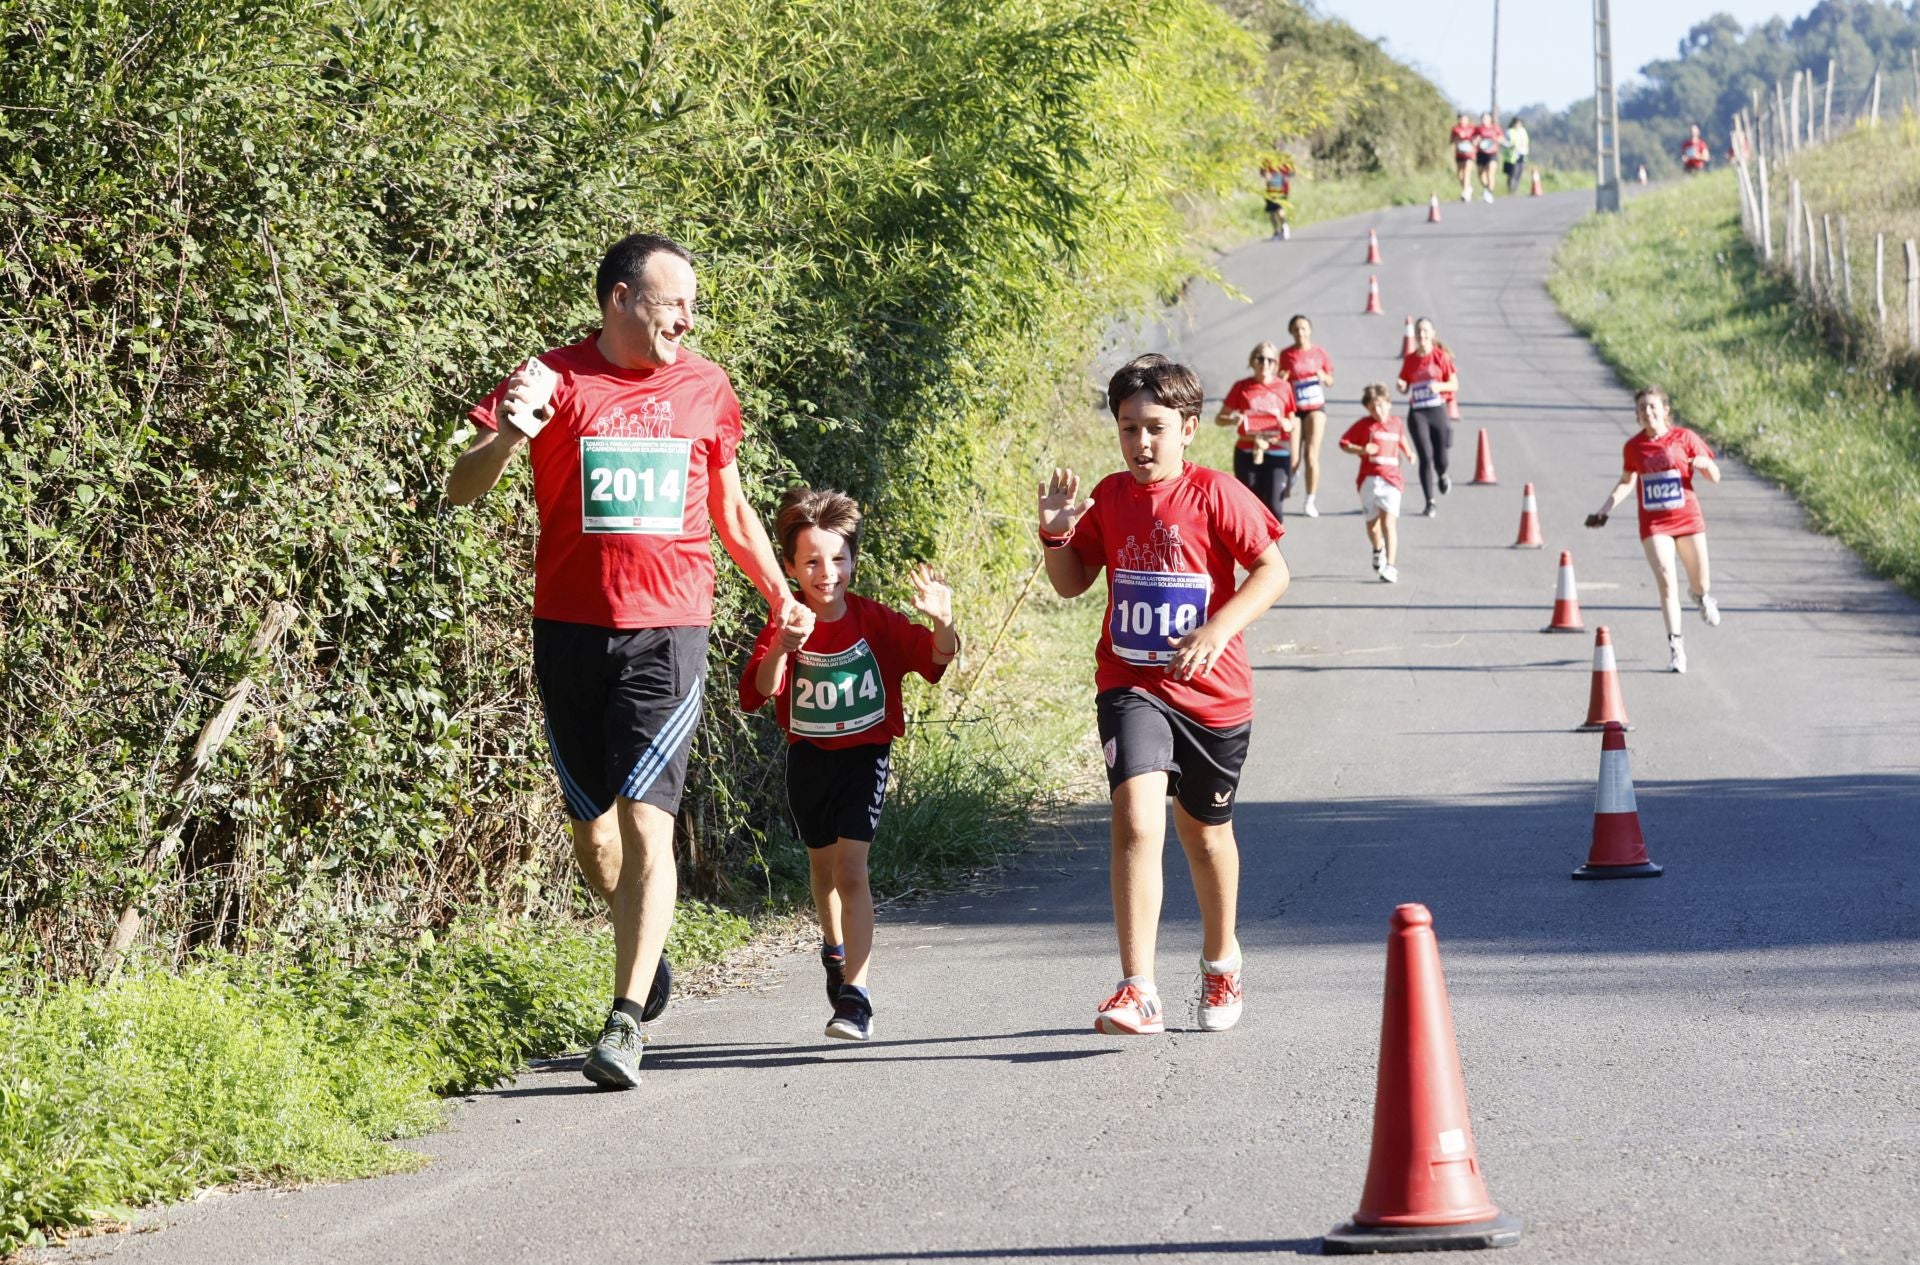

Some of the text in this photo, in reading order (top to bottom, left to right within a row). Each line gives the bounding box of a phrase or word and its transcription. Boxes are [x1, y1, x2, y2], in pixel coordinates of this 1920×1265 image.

[591, 468, 680, 503] 2014
[1646, 482, 1680, 499] 1022
[796, 669, 877, 710] 2014
